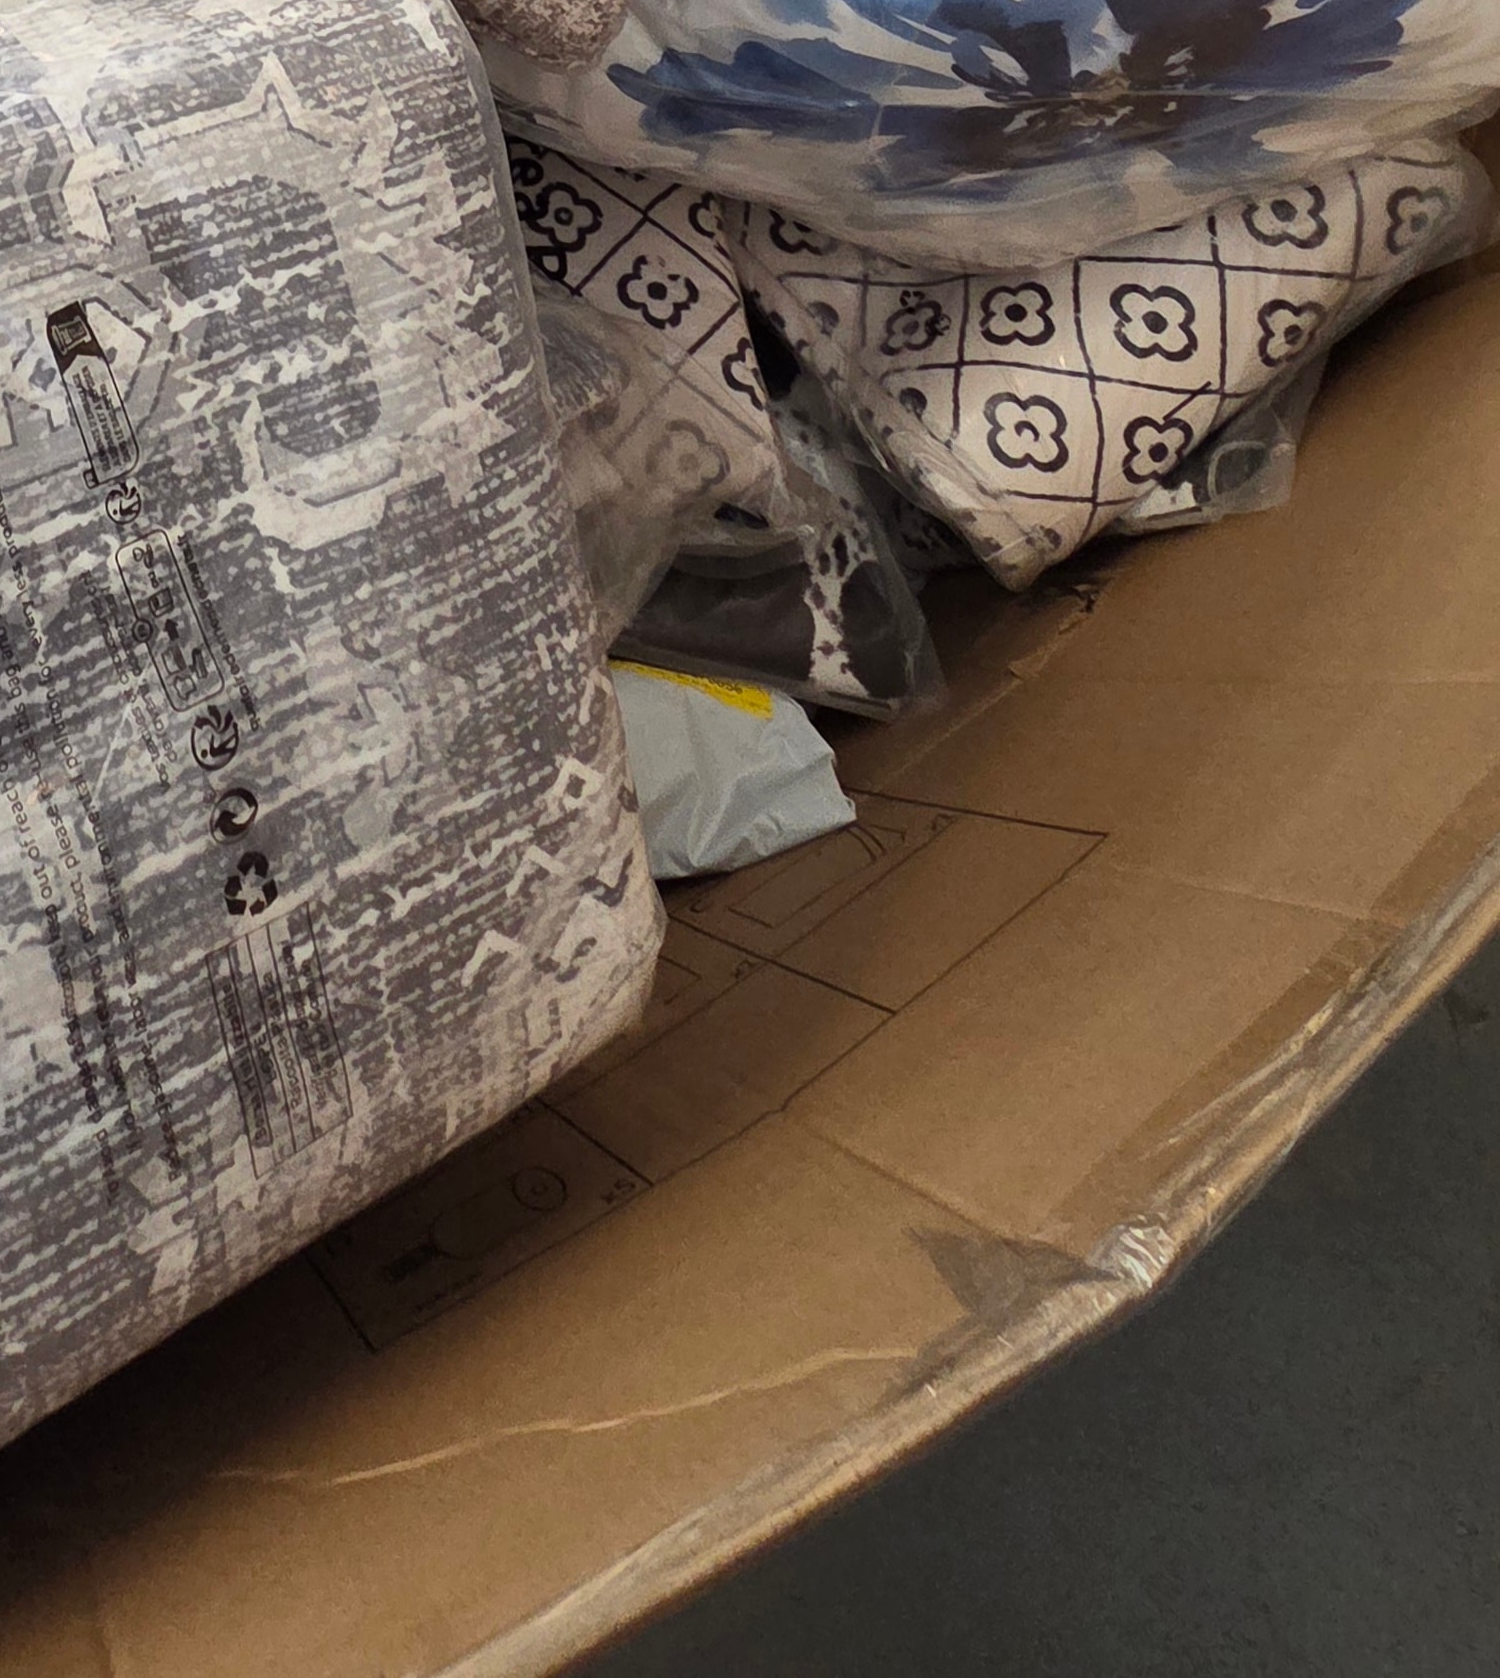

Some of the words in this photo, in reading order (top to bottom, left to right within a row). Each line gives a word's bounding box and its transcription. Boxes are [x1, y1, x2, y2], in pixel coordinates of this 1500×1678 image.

[9, 559, 29, 597] less
[20, 598, 45, 648] every
[2, 662, 24, 700] bag
[43, 686, 80, 769] pollution
[17, 836, 42, 861] of
[43, 803, 82, 870] please
[31, 862, 54, 897] out
